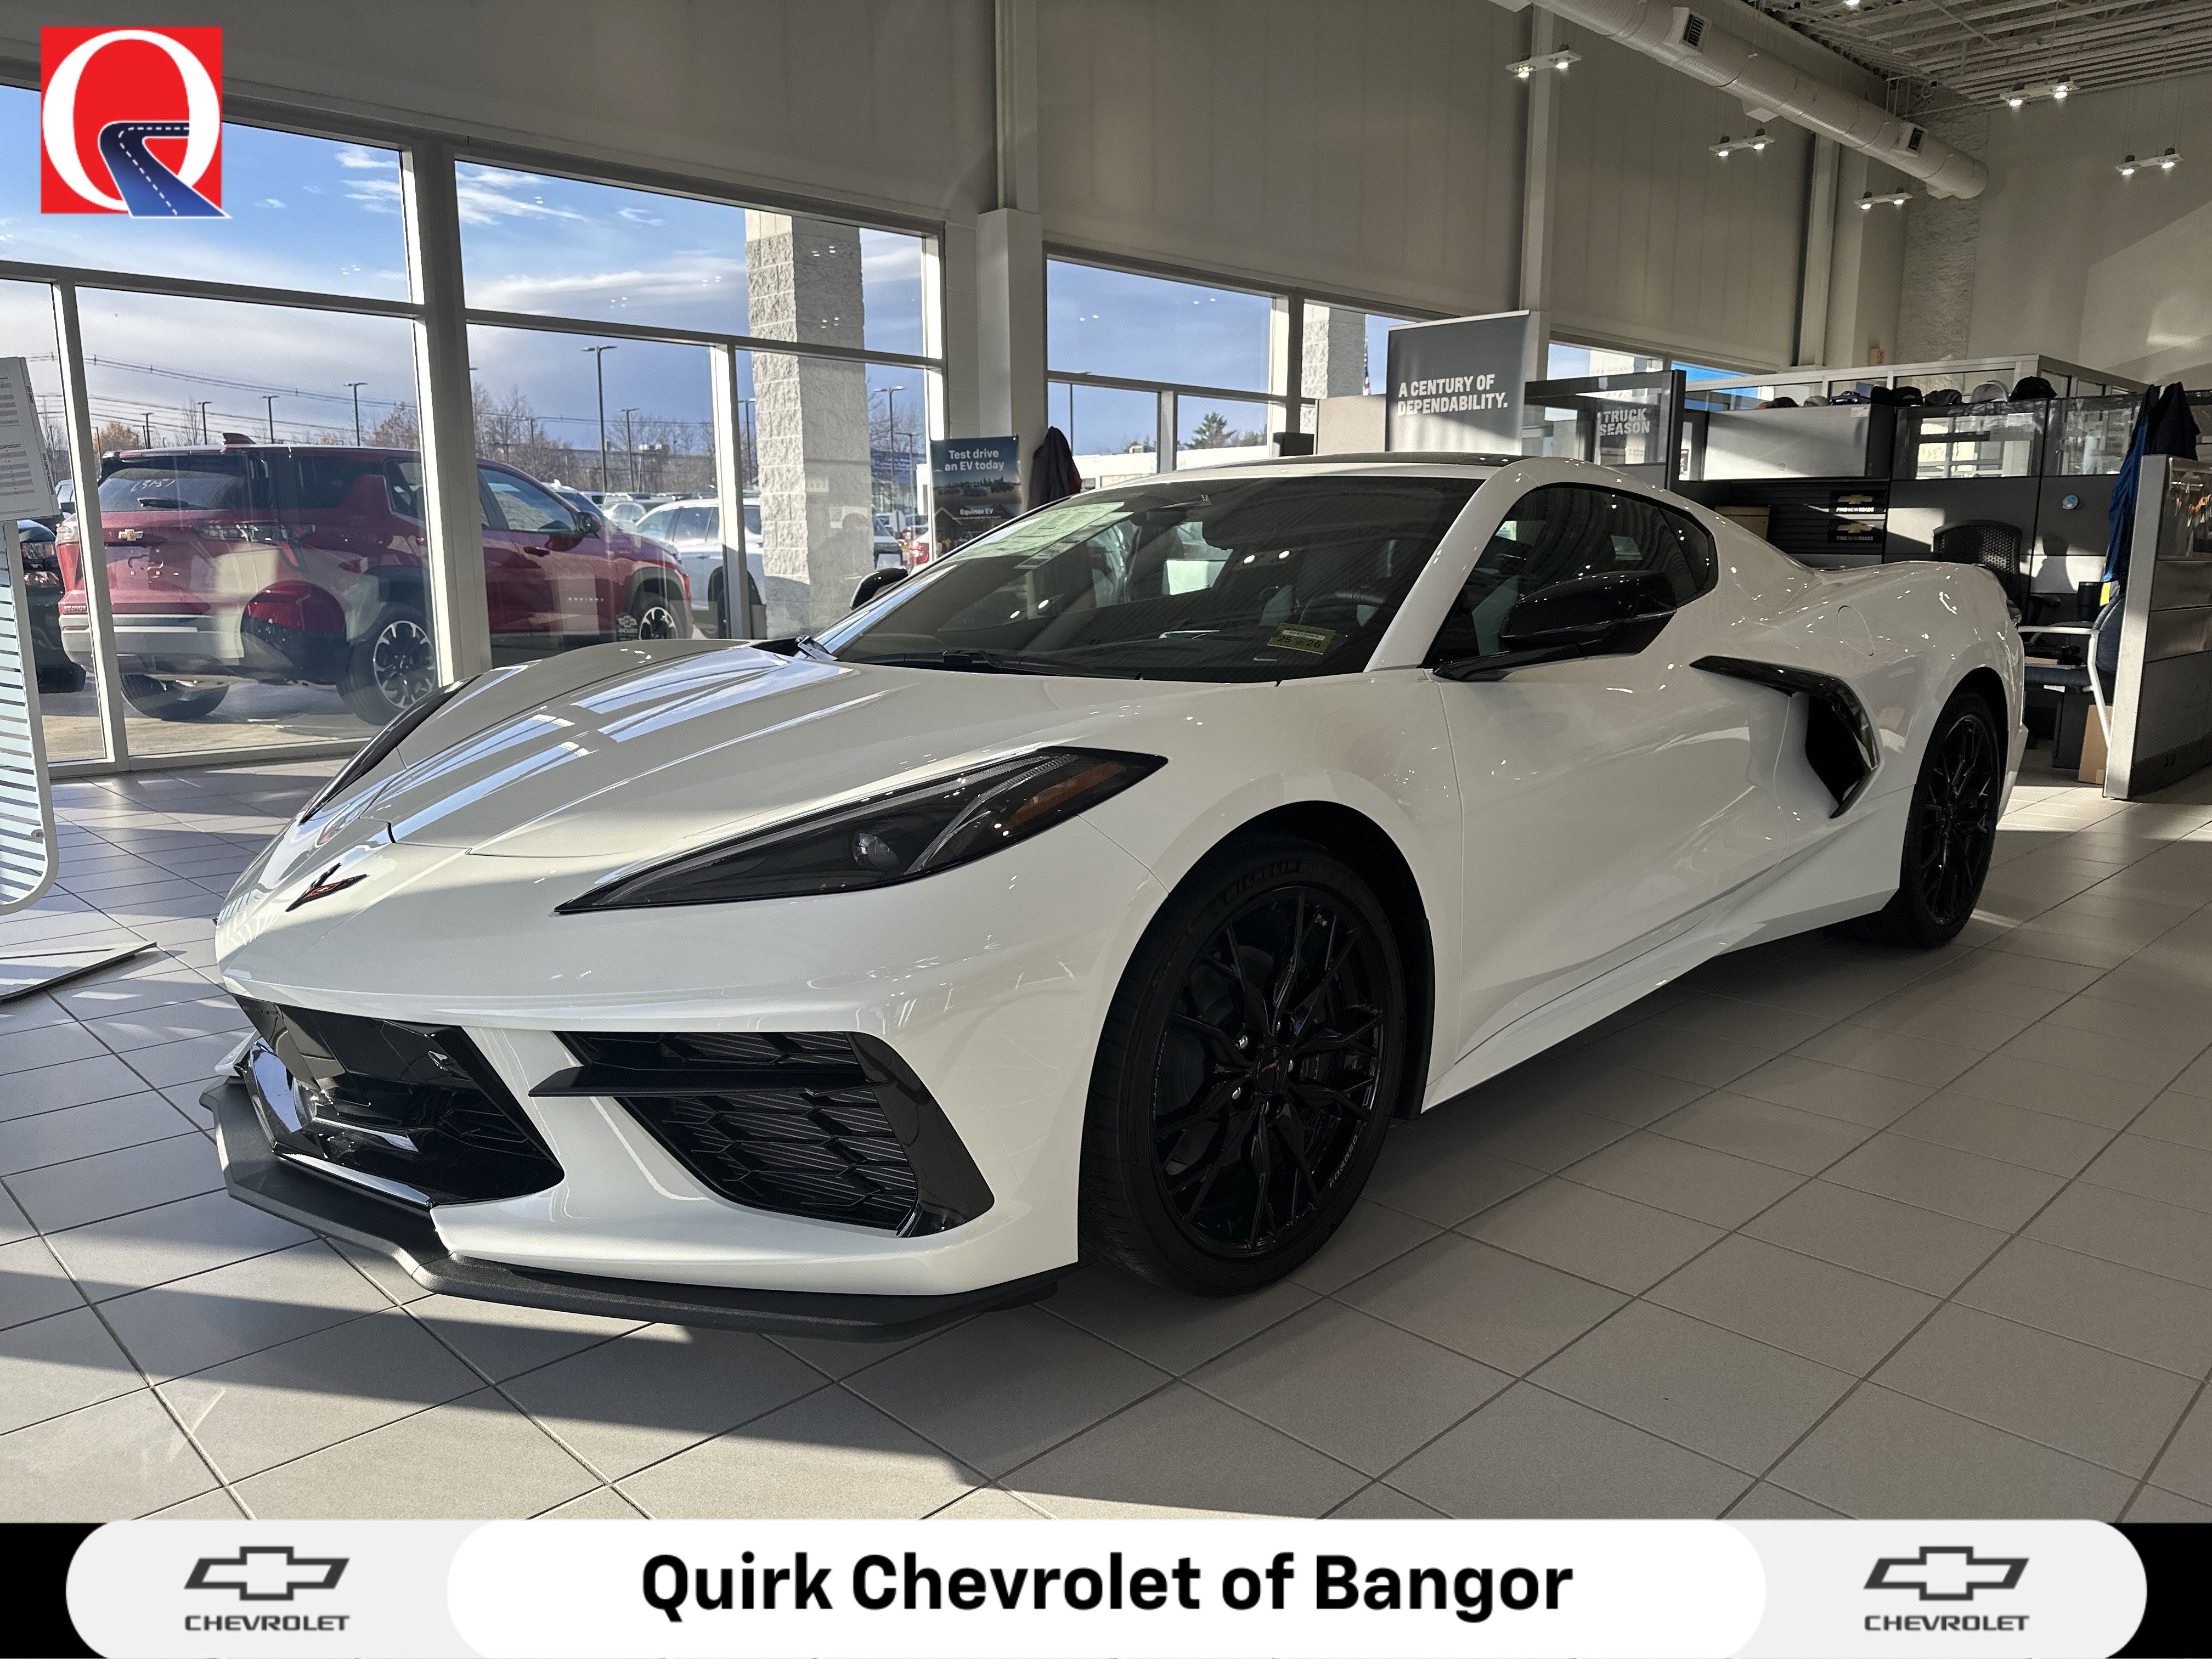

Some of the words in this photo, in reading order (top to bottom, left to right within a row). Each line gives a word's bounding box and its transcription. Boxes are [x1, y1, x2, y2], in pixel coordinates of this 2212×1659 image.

[1398, 382, 1408, 398] A
[1410, 376, 1474, 396] CENTURY
[1476, 374, 1495, 391] OF
[1397, 392, 1508, 416] DEPENDABILITY.
[1603, 408, 1647, 423] TRUCK
[1600, 421, 1650, 436] SEASON
[949, 450, 970, 459] Test
[973, 448, 999, 459] drive
[960, 461, 973, 470] EV
[975, 460, 1005, 471] today
[1306, 640, 1322, 648] 26
[1329, 1135, 1358, 1188] FORGED
